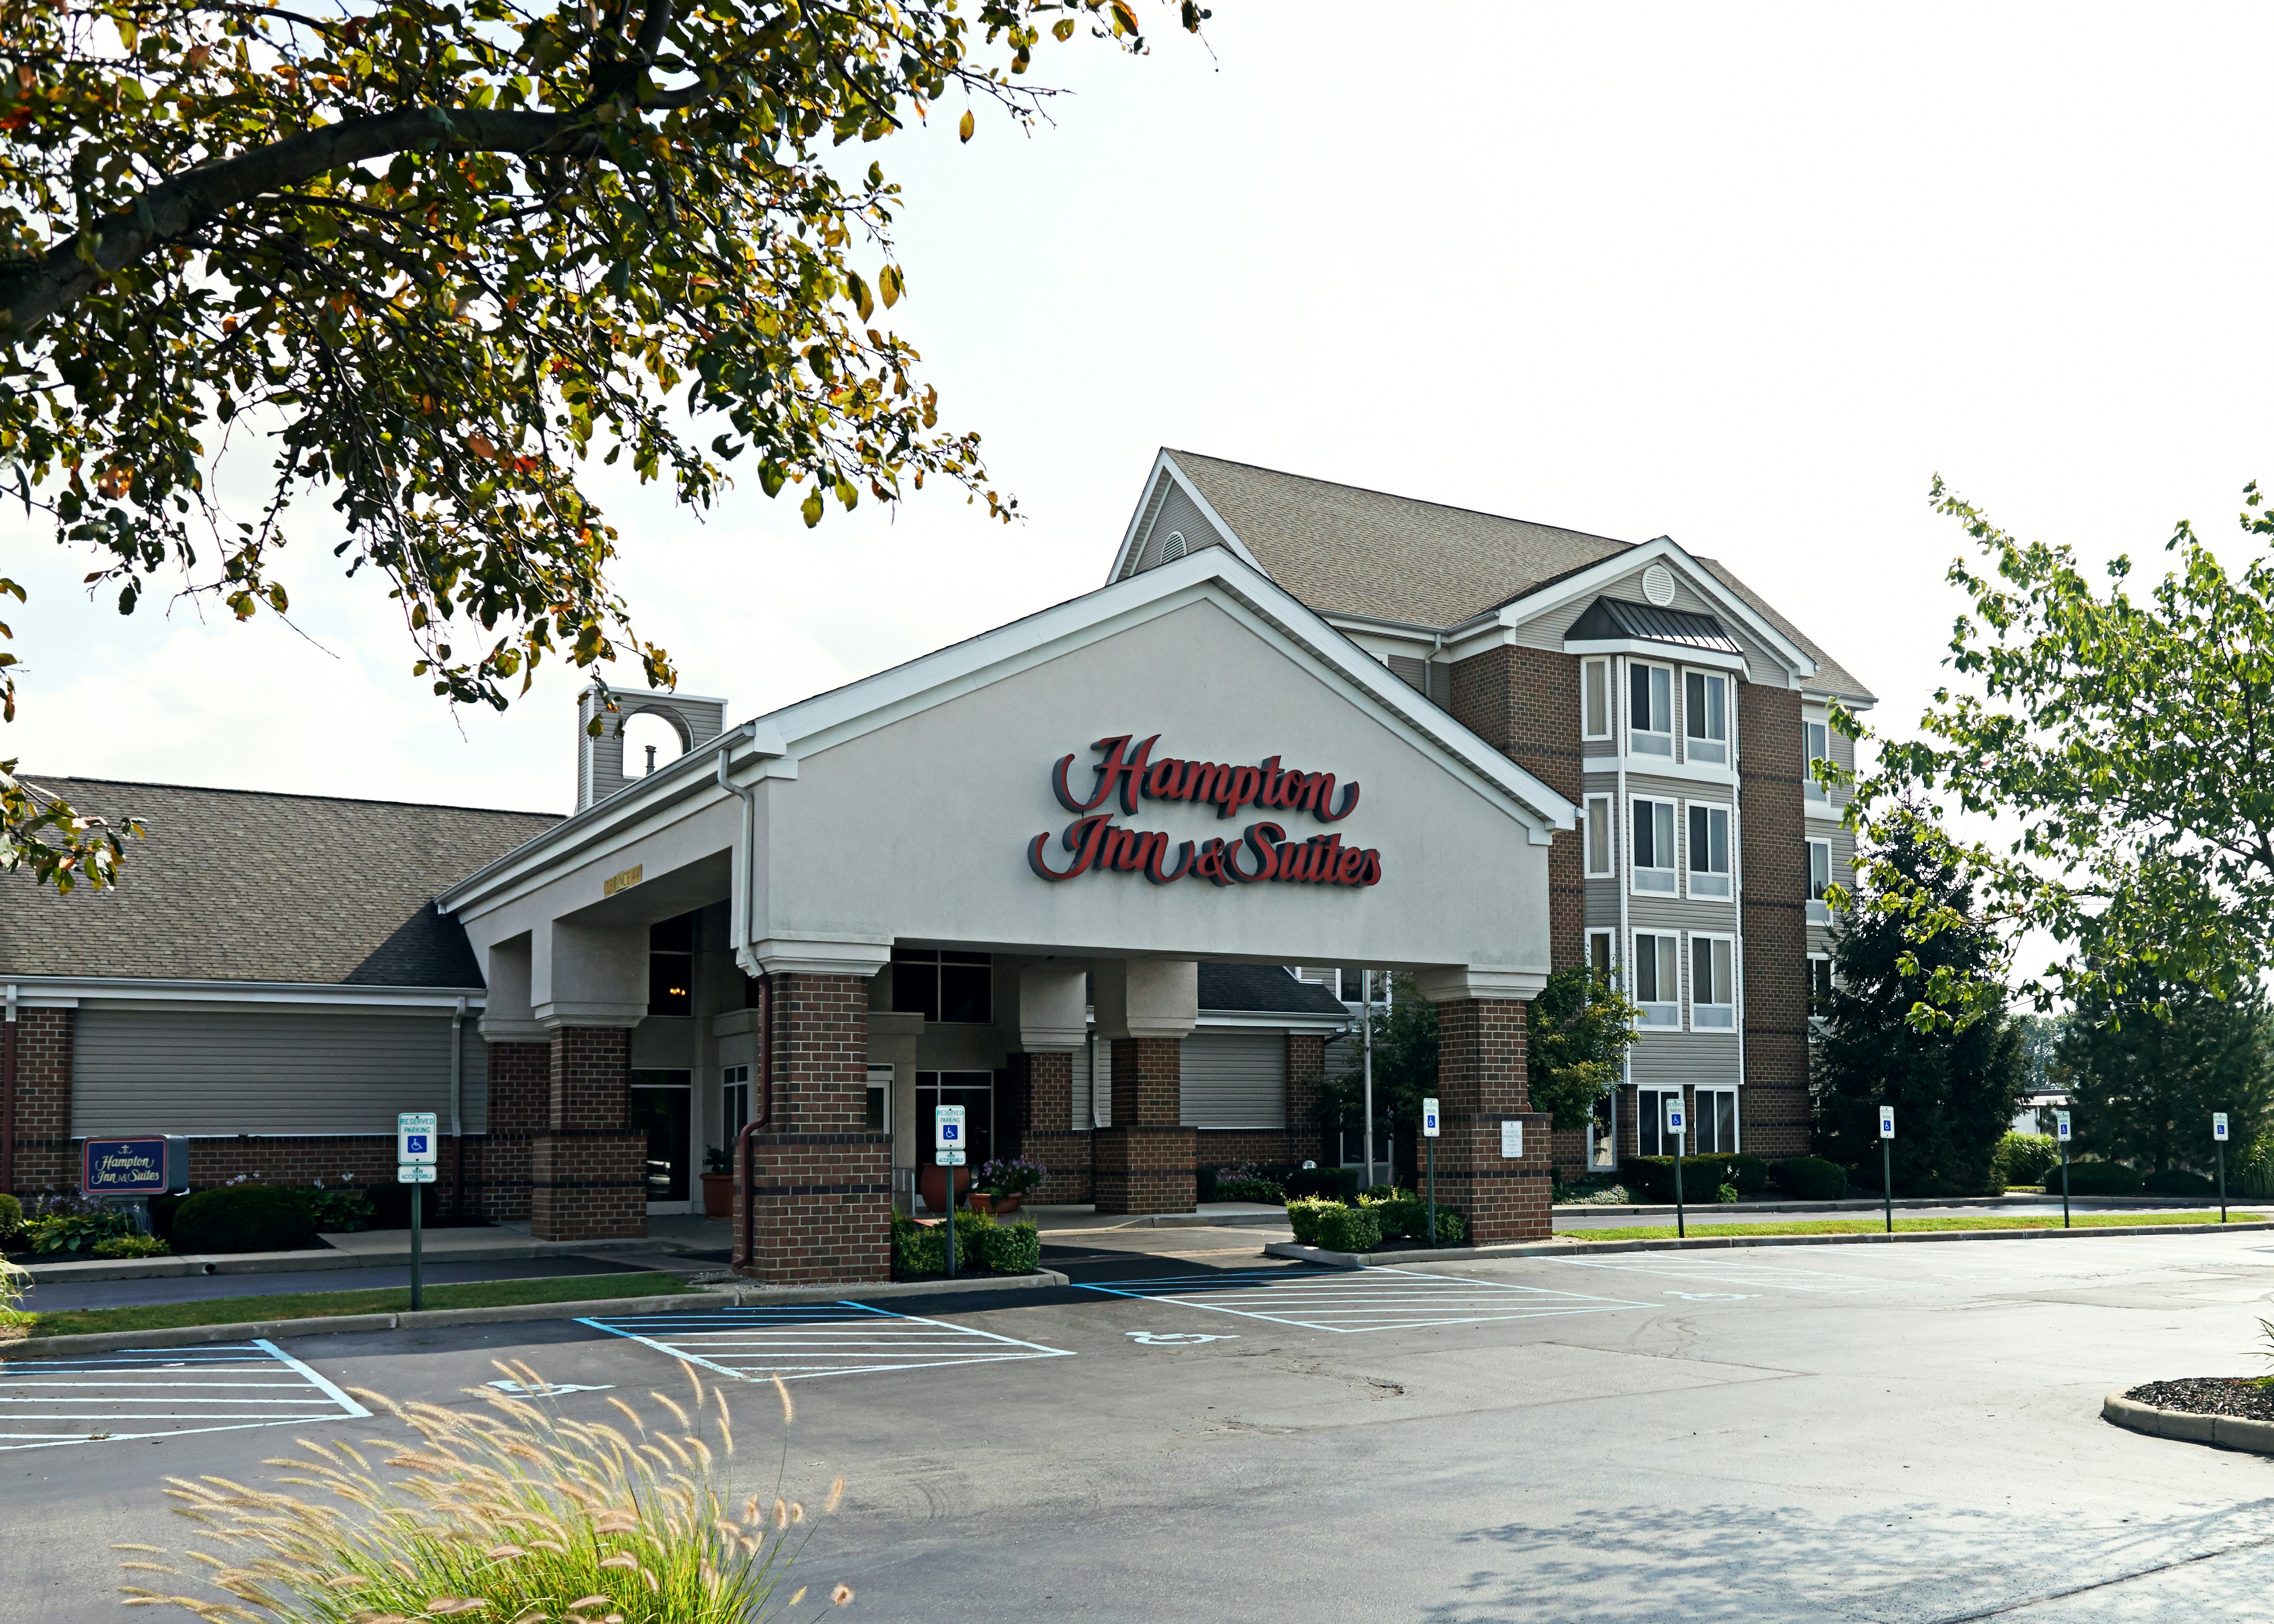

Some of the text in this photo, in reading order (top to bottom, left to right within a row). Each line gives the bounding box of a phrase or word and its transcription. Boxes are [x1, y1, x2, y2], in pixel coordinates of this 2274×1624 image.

[1053, 734, 1359, 823] Hampton
[1027, 814, 1381, 887] Inn & Suites
[92, 1170, 159, 1184] Inn & Suites
[95, 1155, 154, 1171] Hampton
